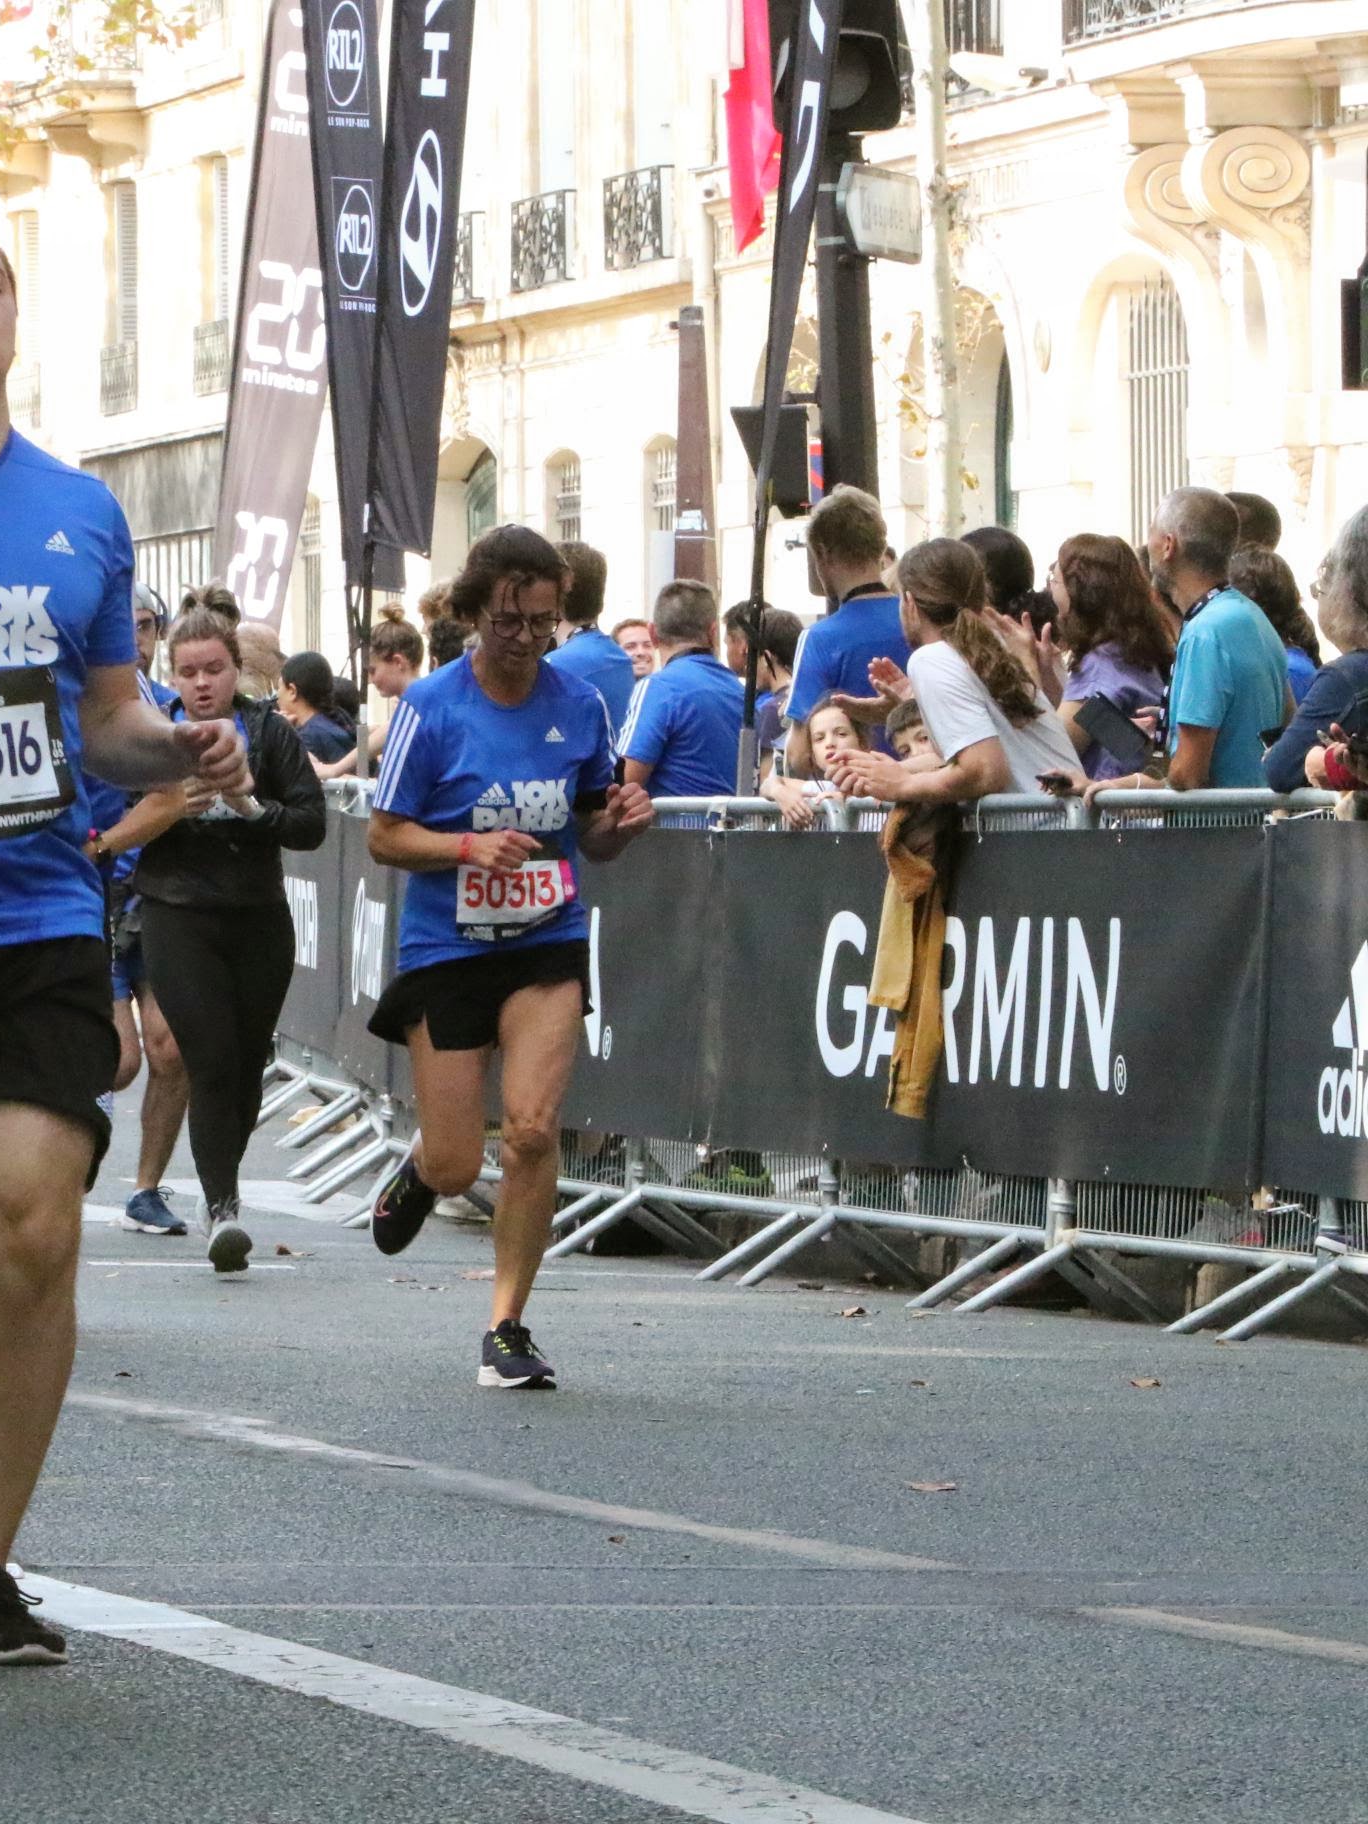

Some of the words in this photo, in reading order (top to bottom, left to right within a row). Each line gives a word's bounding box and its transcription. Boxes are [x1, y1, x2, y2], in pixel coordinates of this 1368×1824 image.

[328, 29, 362, 70] RTL2
[339, 213, 371, 256] RTL2
[244, 259, 327, 372] 20
[241, 365, 319, 395] minutes
[512, 778, 569, 809] 10K
[473, 806, 569, 832] PARIS
[464, 870, 556, 909] 50313
[1317, 1047, 1368, 1138] adi
